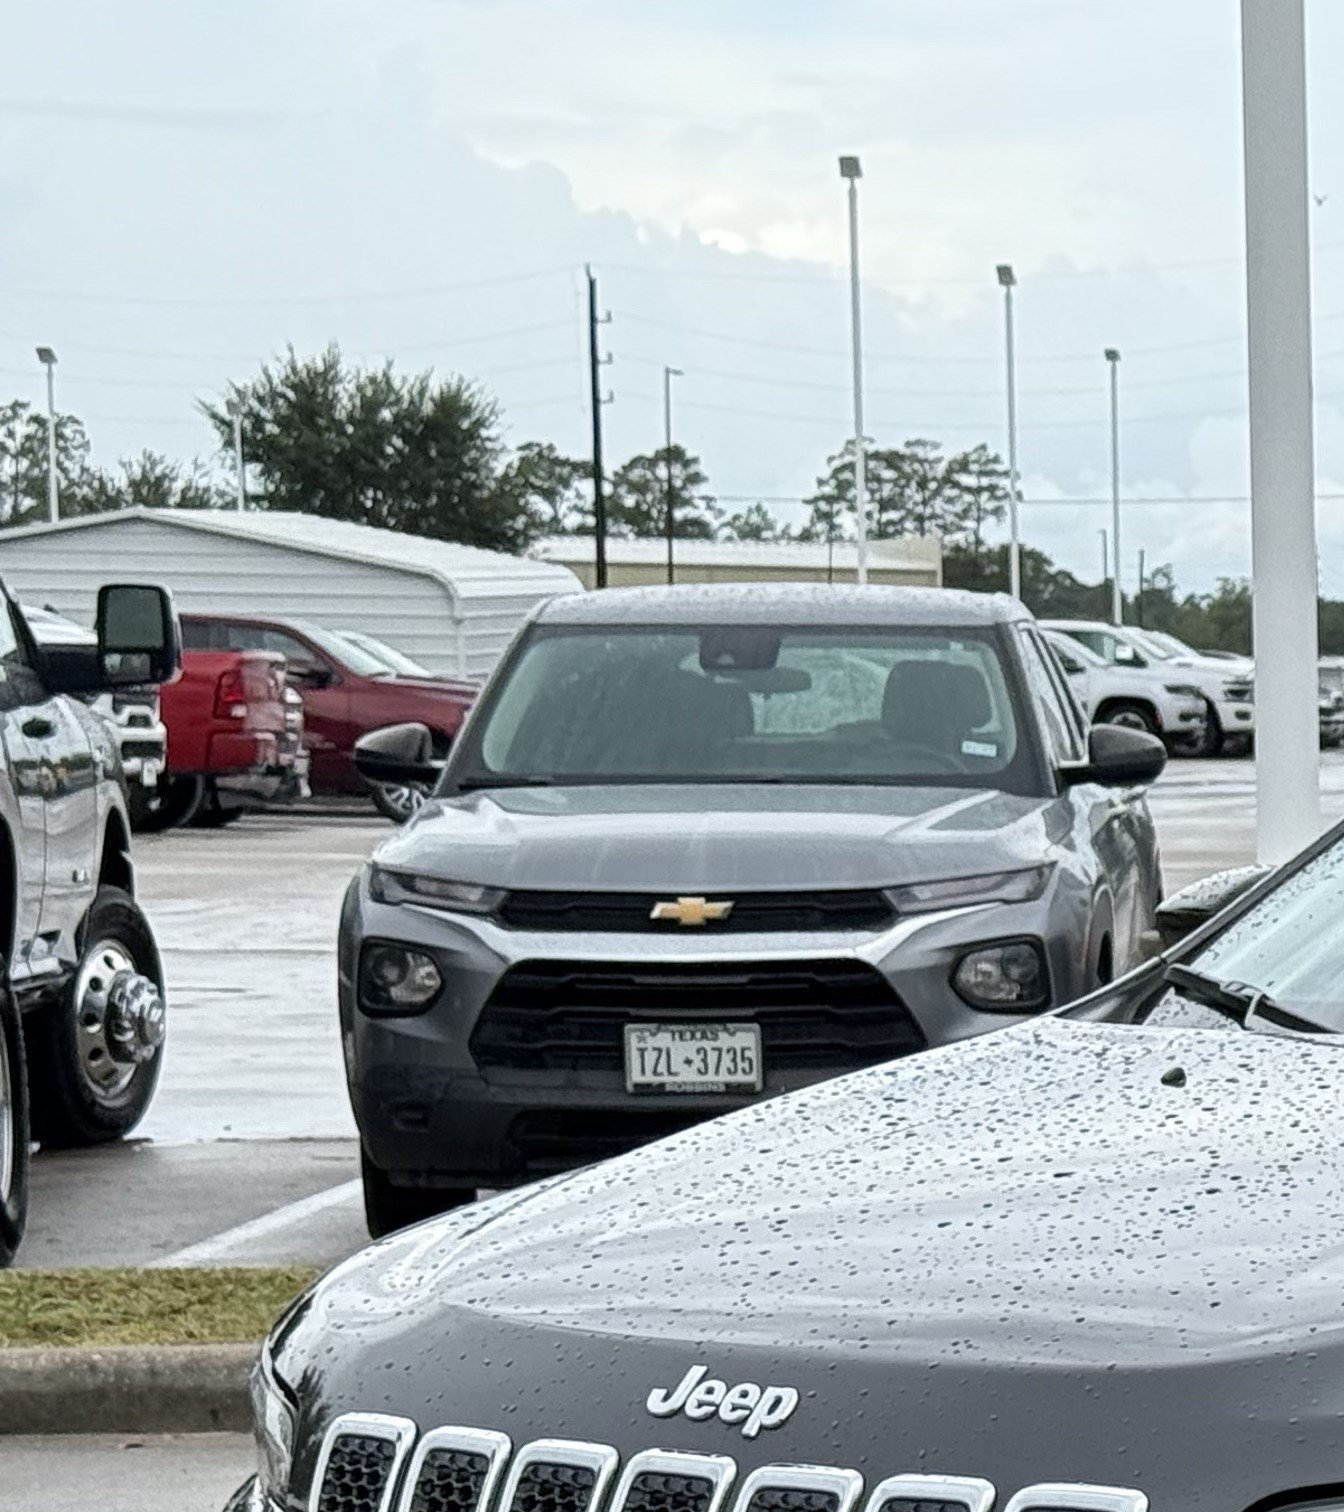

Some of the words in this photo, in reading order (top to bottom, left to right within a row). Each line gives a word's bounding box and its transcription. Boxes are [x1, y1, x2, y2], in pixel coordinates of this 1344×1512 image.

[670, 1028, 720, 1042] TEXAS
[636, 1046, 681, 1077] TZL
[695, 1046, 754, 1077] 3735
[646, 1364, 799, 1438] Jeep
